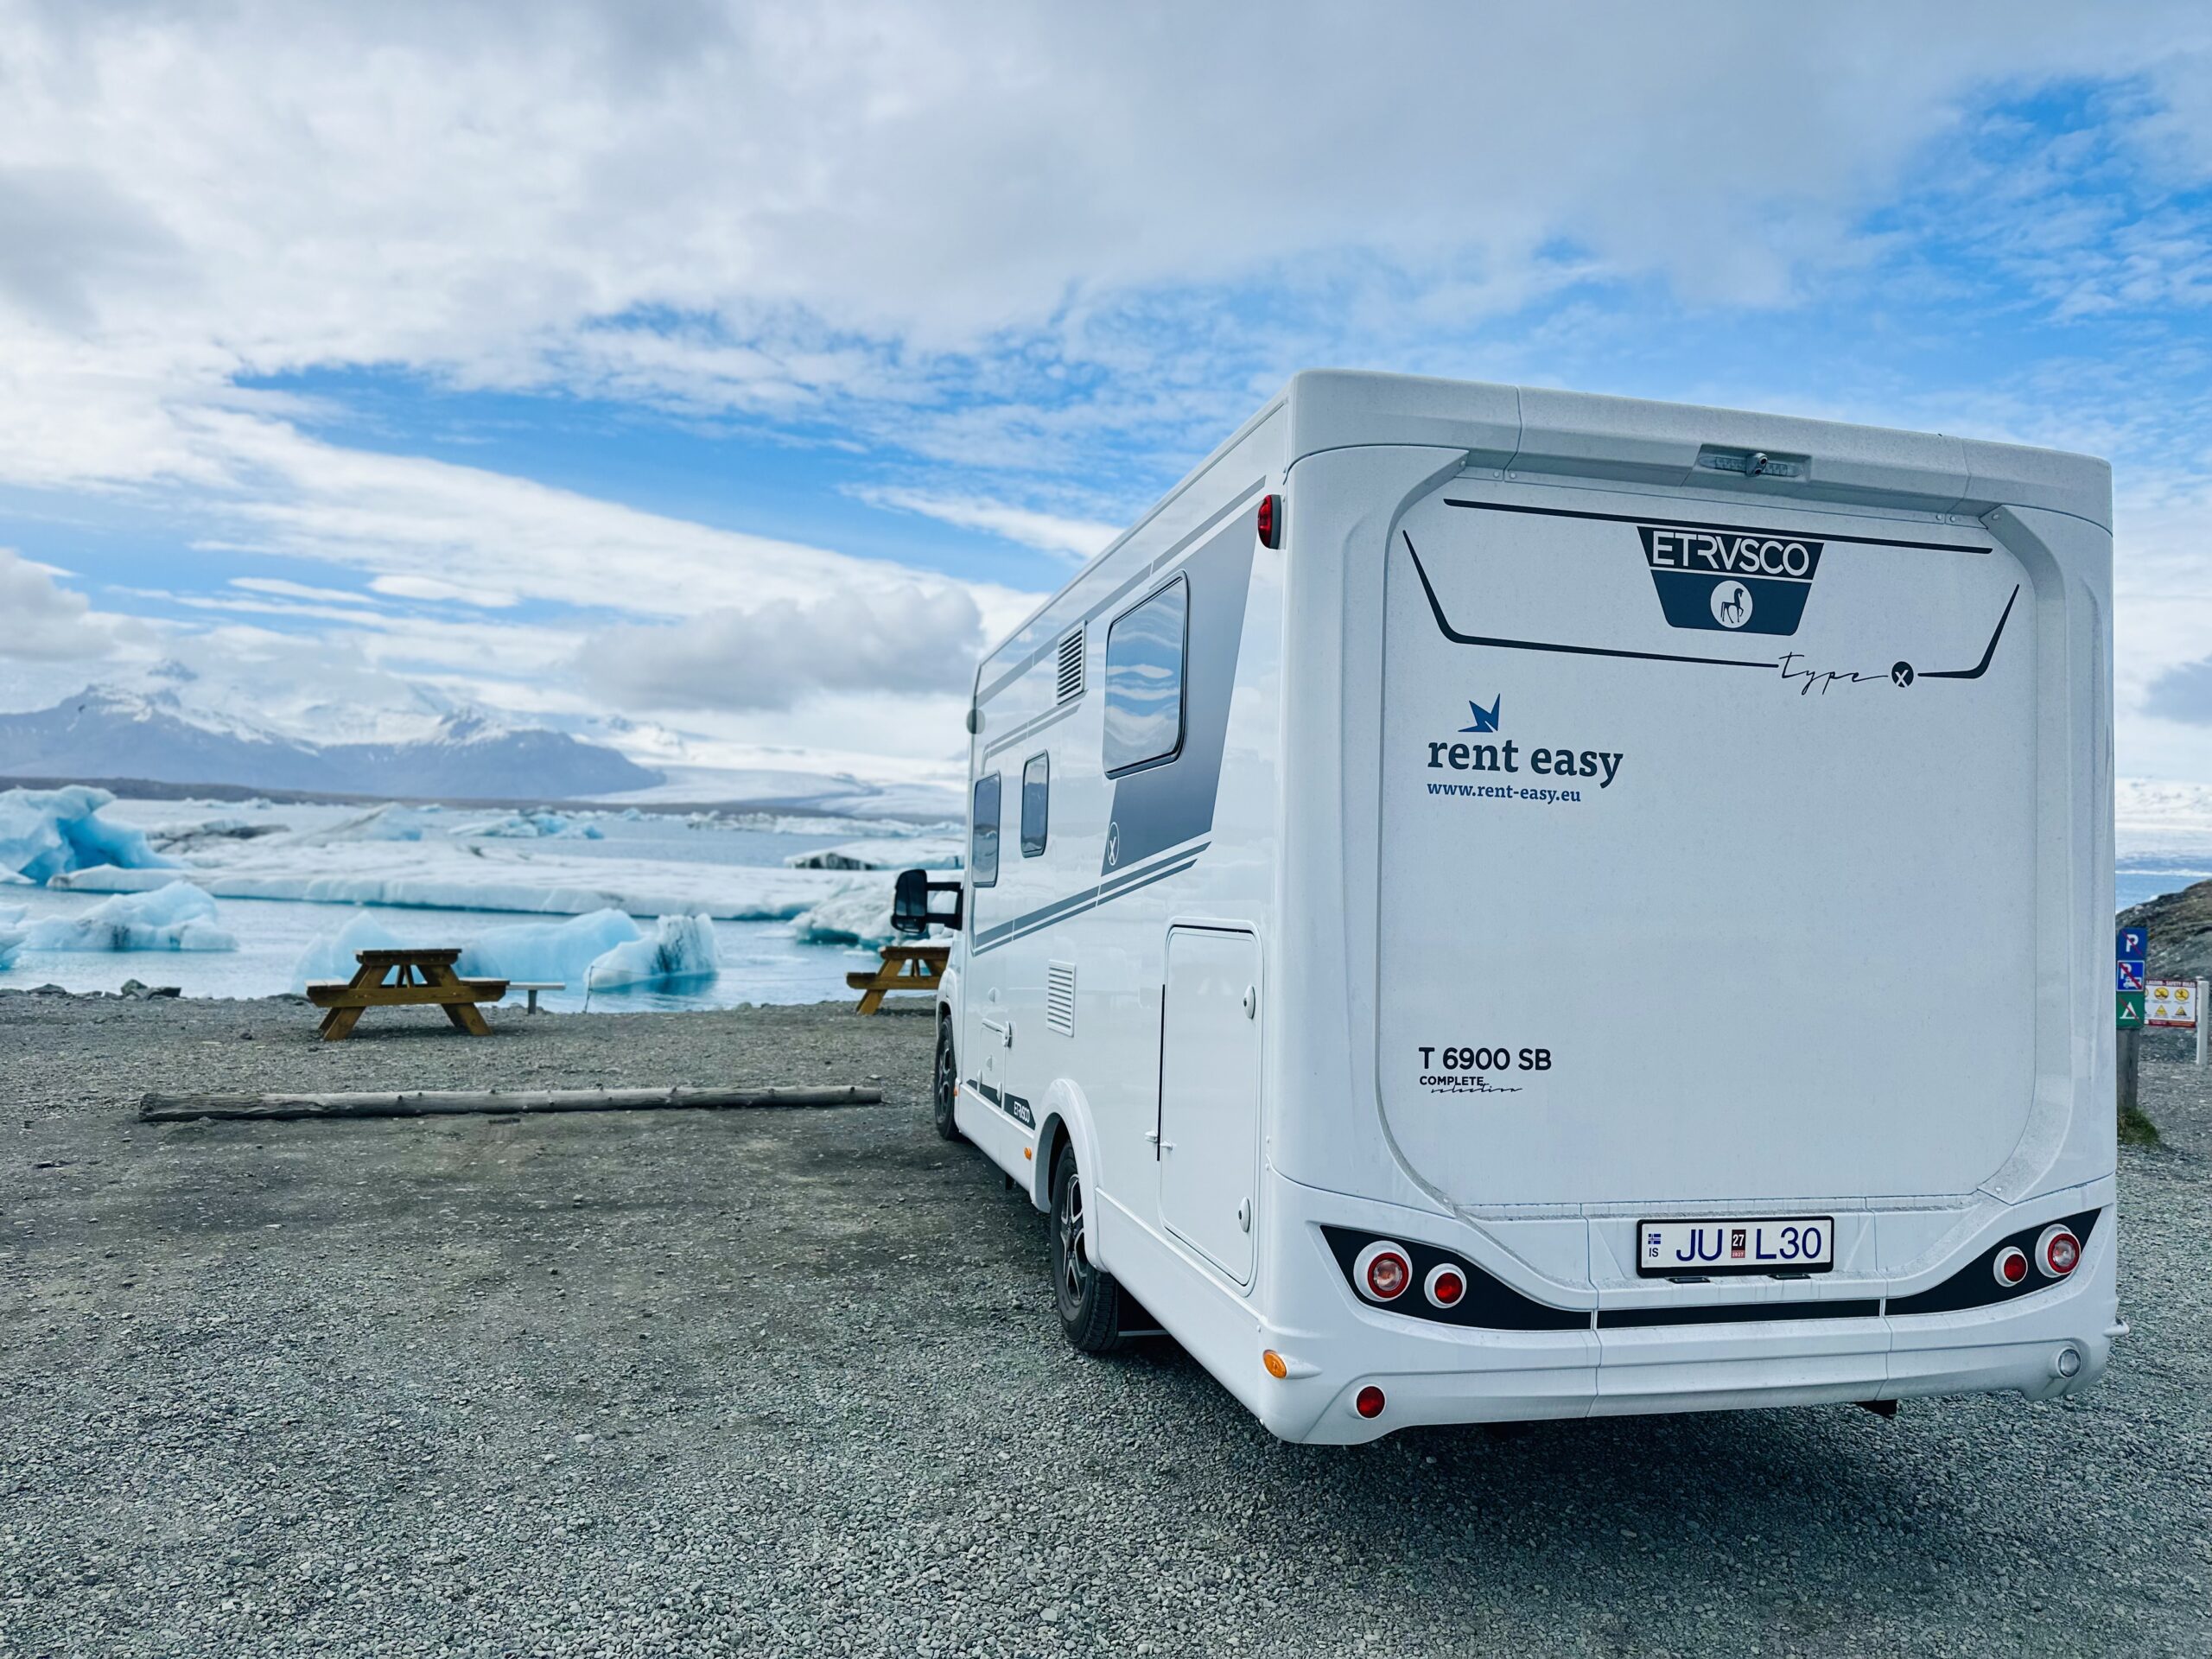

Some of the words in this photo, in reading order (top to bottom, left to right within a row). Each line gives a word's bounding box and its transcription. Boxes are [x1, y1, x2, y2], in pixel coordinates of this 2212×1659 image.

[1778, 652, 1889, 696] type
[1427, 740, 1519, 773] rent
[1530, 748, 1624, 789] easy
[1427, 783, 1581, 805] www.rent-easy.eu
[2126, 934, 2139, 952] P
[1418, 1046, 1435, 1070] T
[1442, 1046, 1510, 1071] 6900
[1518, 1047, 1552, 1071] SB
[1419, 1076, 1484, 1086] COMPLETE
[1649, 1247, 1659, 1258] IS
[1675, 1229, 1723, 1262] JU
[1732, 1234, 1745, 1247] 27
[1756, 1226, 1822, 1260] L30
